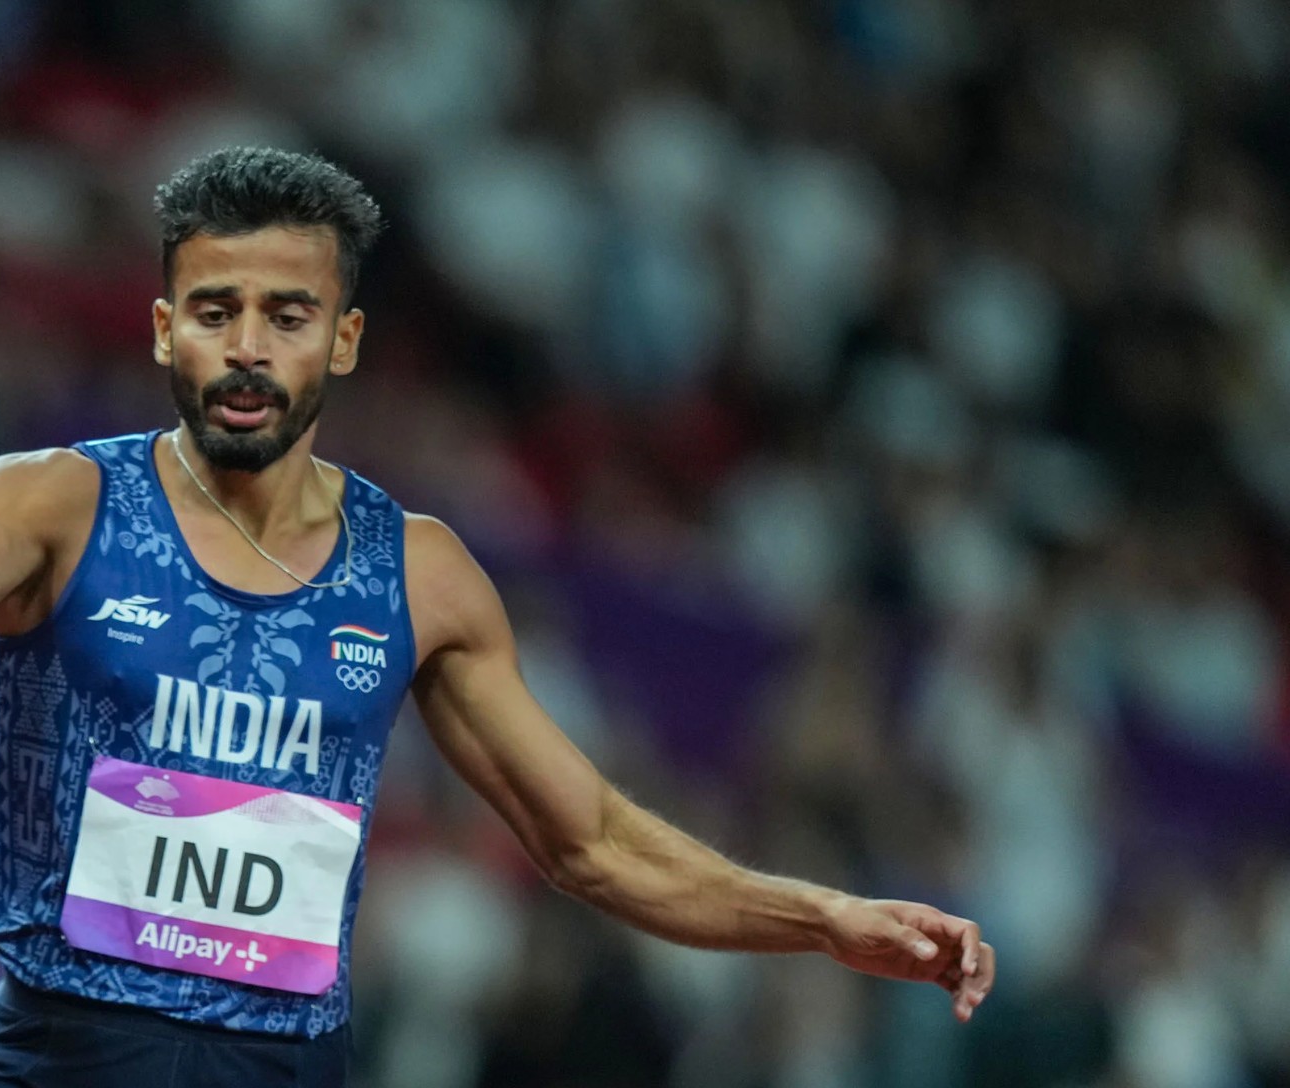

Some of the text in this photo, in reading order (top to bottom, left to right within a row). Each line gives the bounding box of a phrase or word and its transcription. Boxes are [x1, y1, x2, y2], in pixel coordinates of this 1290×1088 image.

[86, 597, 171, 629] JSW
[331, 641, 387, 668] INDIA
[149, 674, 322, 775] INDIA
[144, 836, 285, 917] IND
[136, 921, 233, 965] Alipay
